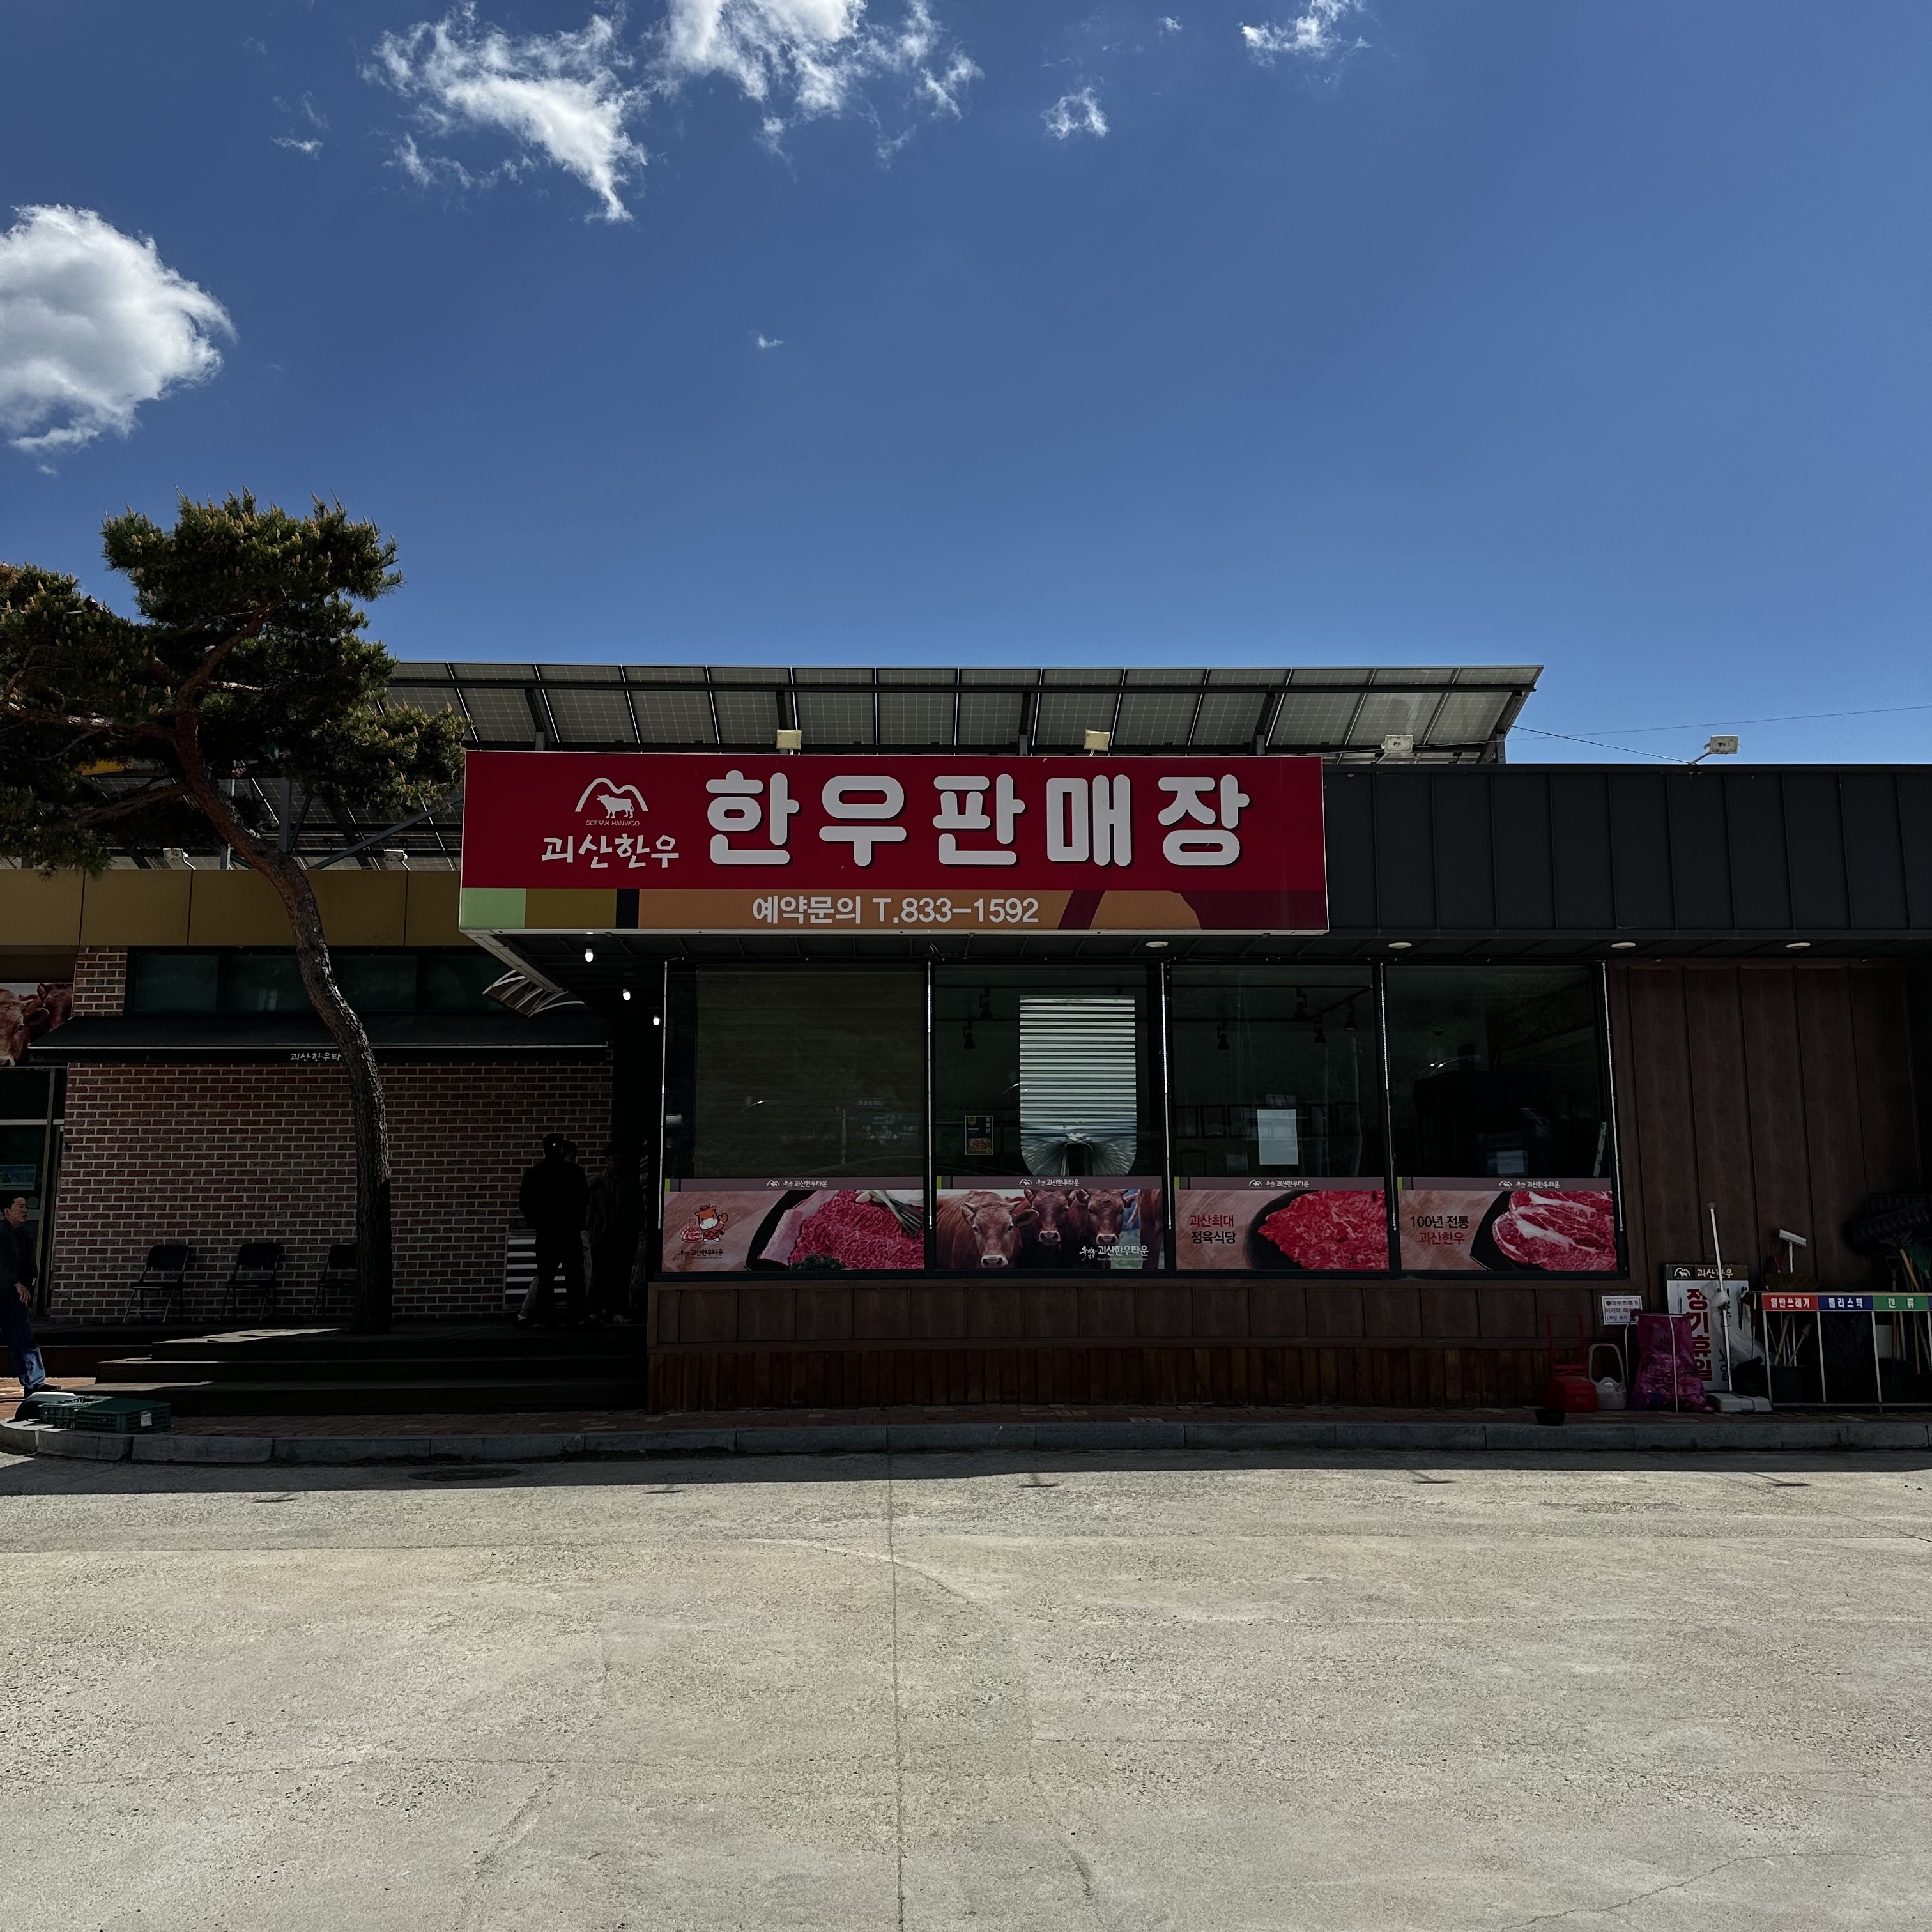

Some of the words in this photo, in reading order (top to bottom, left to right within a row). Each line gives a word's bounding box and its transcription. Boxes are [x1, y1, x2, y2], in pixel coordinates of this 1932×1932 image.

[542, 833, 680, 869] 괴산한우
[753, 896, 861, 924] 예약문의
[872, 897, 1039, 924] T.833-1592
[290, 1052, 342, 1061] 괴산한우타
[1190, 1215, 1234, 1227] 괴산최대
[1410, 1216, 1443, 1228] 100년
[1446, 1216, 1469, 1229] 전통
[1191, 1230, 1236, 1244] 정육식당
[1418, 1232, 1465, 1245] 괴산한우
[1098, 1245, 1149, 1257] 괴산한우타운
[1770, 1298, 1810, 1308] 일반쓰레기
[1828, 1298, 1863, 1308] 플라스틱
